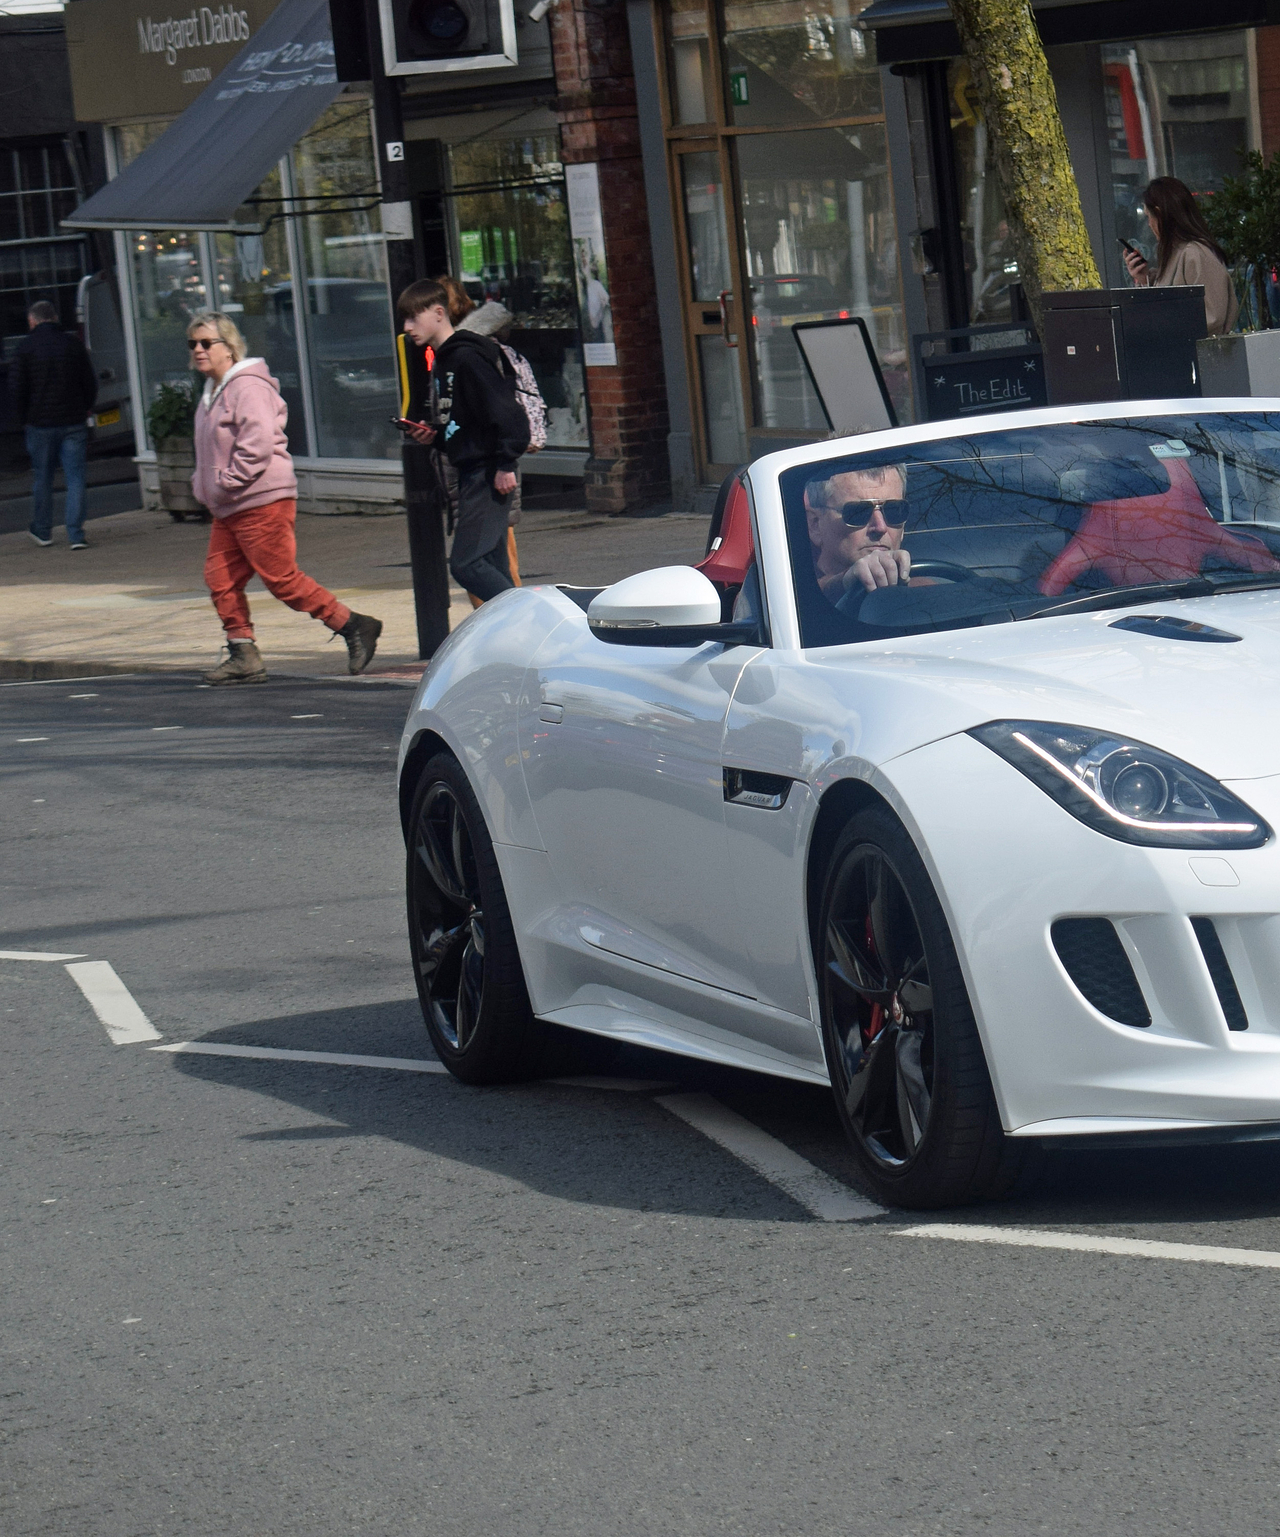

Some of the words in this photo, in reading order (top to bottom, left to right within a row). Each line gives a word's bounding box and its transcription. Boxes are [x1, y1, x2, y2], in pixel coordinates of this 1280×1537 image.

[138, 10, 201, 65] Margaret
[200, 4, 250, 46] Dabbs
[182, 67, 212, 83] LONDON
[392, 145, 402, 158] 2
[953, 382, 988, 404] The
[989, 378, 1027, 400] Edit
[743, 794, 772, 803] JAGUAR
